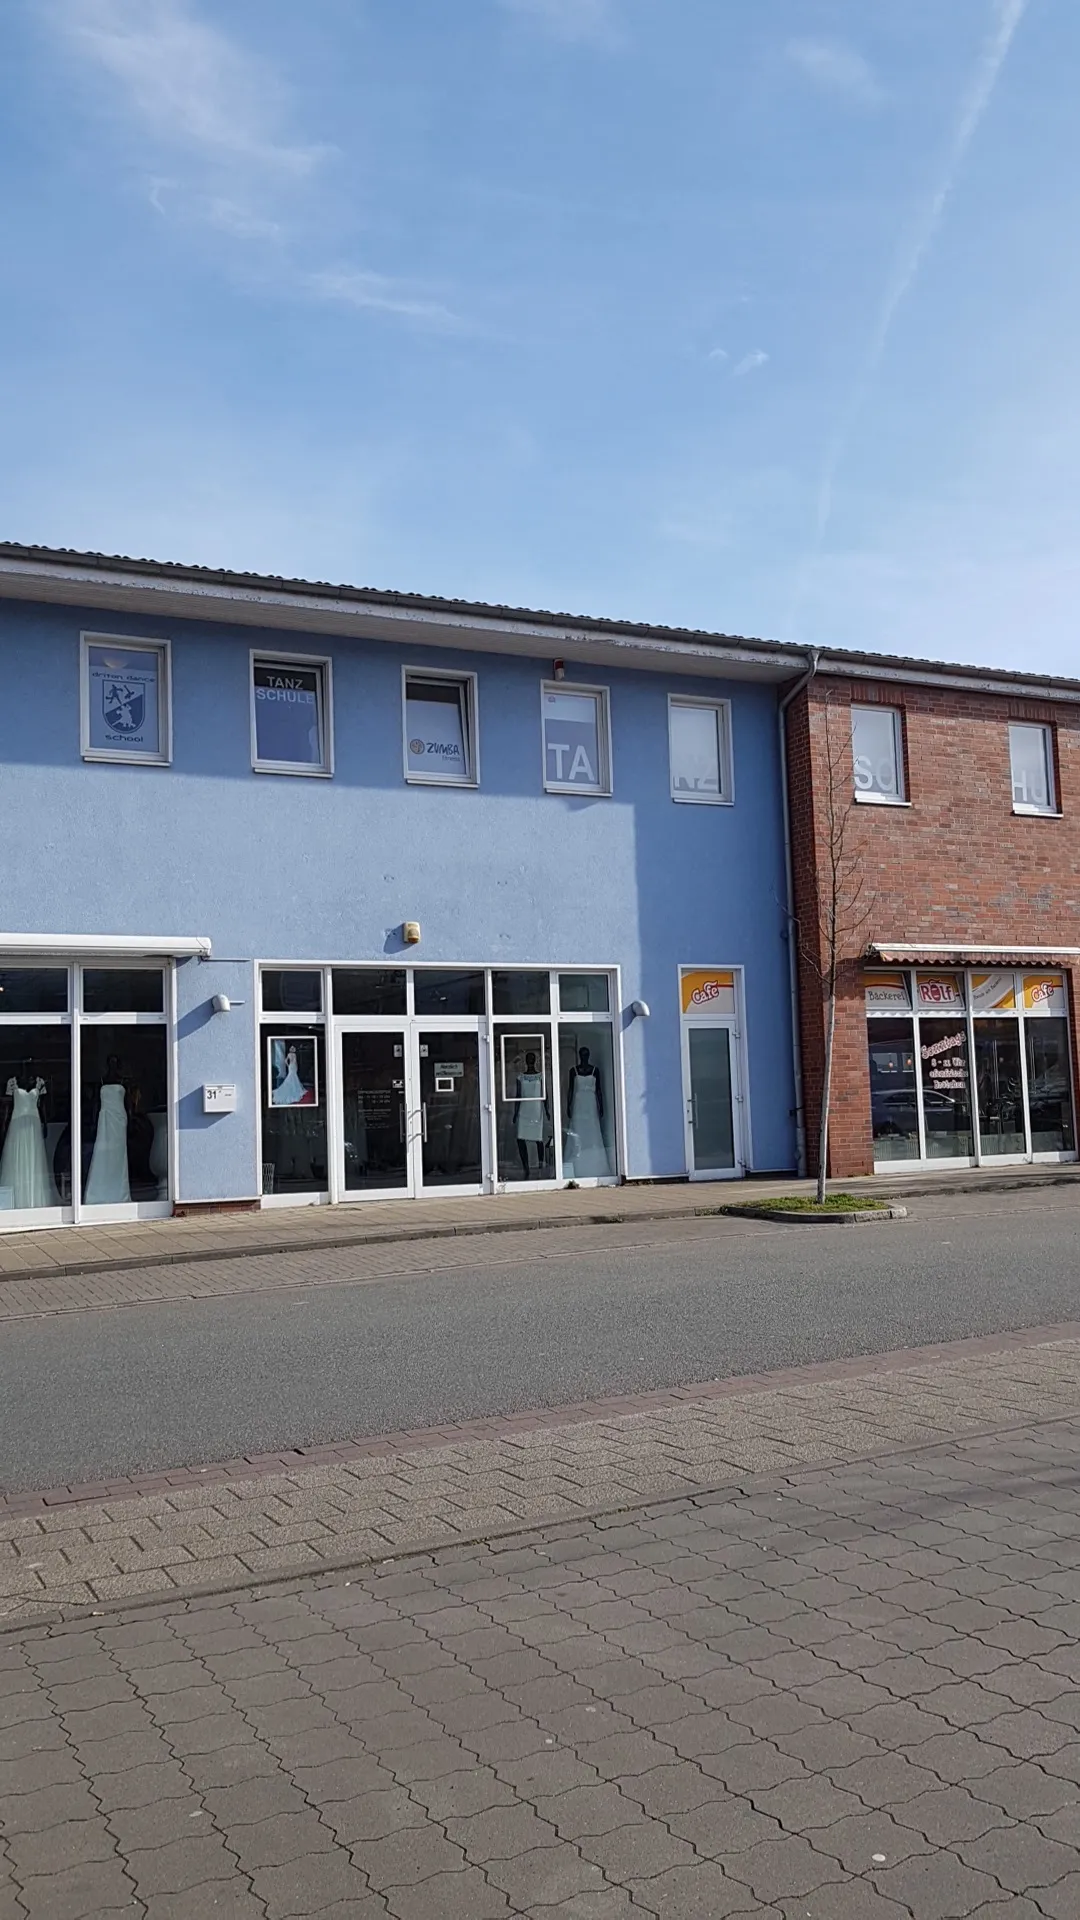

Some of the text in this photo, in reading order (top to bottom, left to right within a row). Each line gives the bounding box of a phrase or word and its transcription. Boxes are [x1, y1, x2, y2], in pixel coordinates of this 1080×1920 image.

[126, 675, 156, 683] dance
[266, 675, 304, 690] TANZ
[256, 688, 313, 704] SCHULE
[105, 734, 144, 743] school
[426, 742, 460, 755] ZUMBA
[547, 742, 595, 781] TA
[206, 1089, 217, 1100] 31
